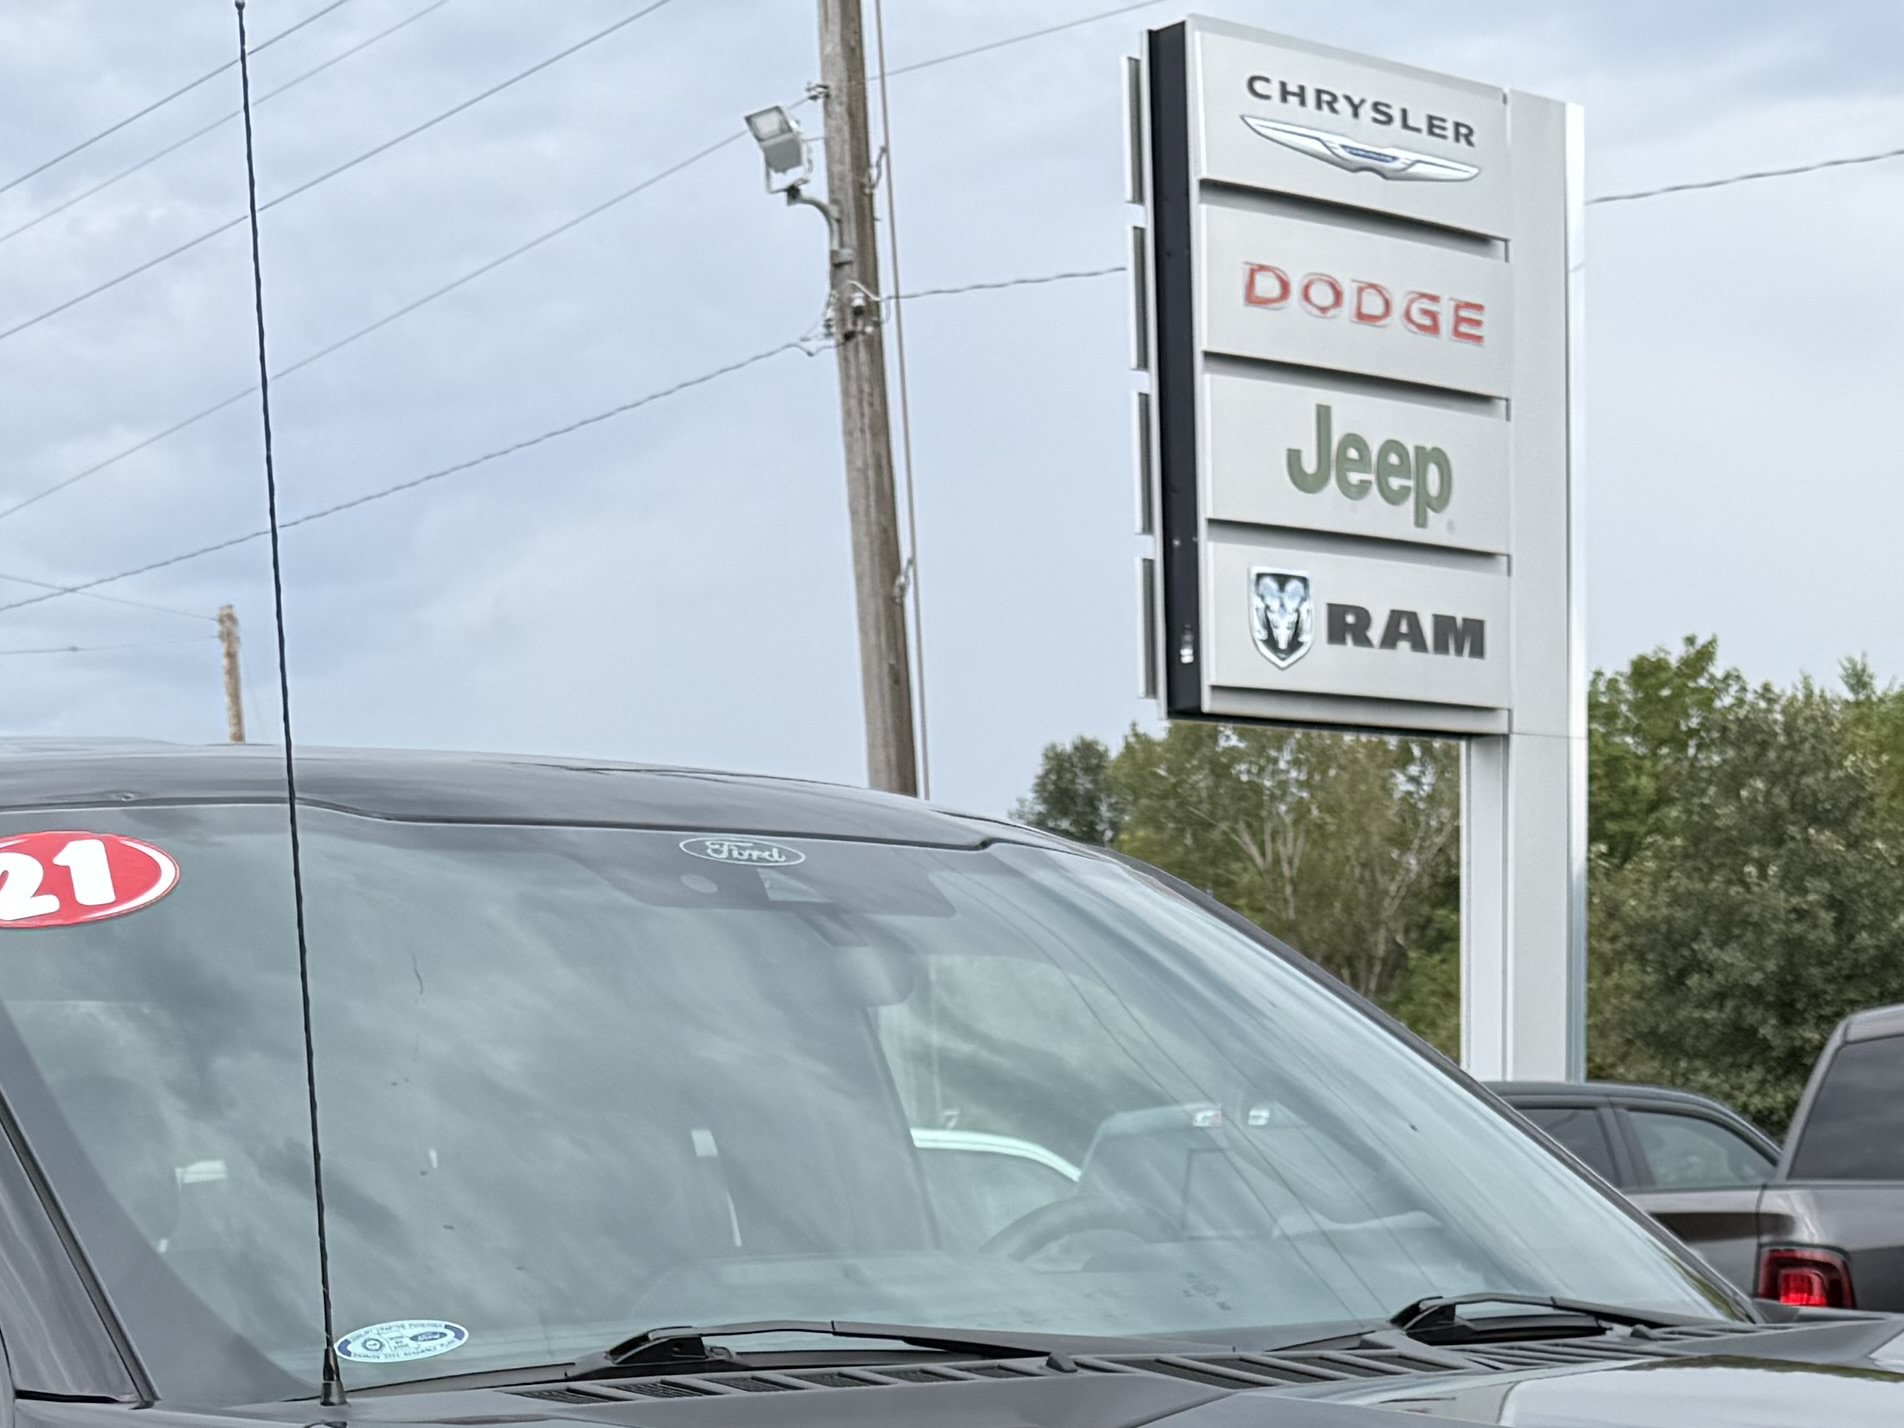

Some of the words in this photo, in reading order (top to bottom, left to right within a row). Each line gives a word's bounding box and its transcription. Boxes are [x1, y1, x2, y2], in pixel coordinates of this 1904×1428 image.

[1244, 74, 1476, 148] CHRYSLER
[1242, 261, 1486, 346] DODGE
[1286, 404, 1453, 528] Jeep
[1325, 602, 1487, 660] RAM
[704, 840, 786, 862] Ford
